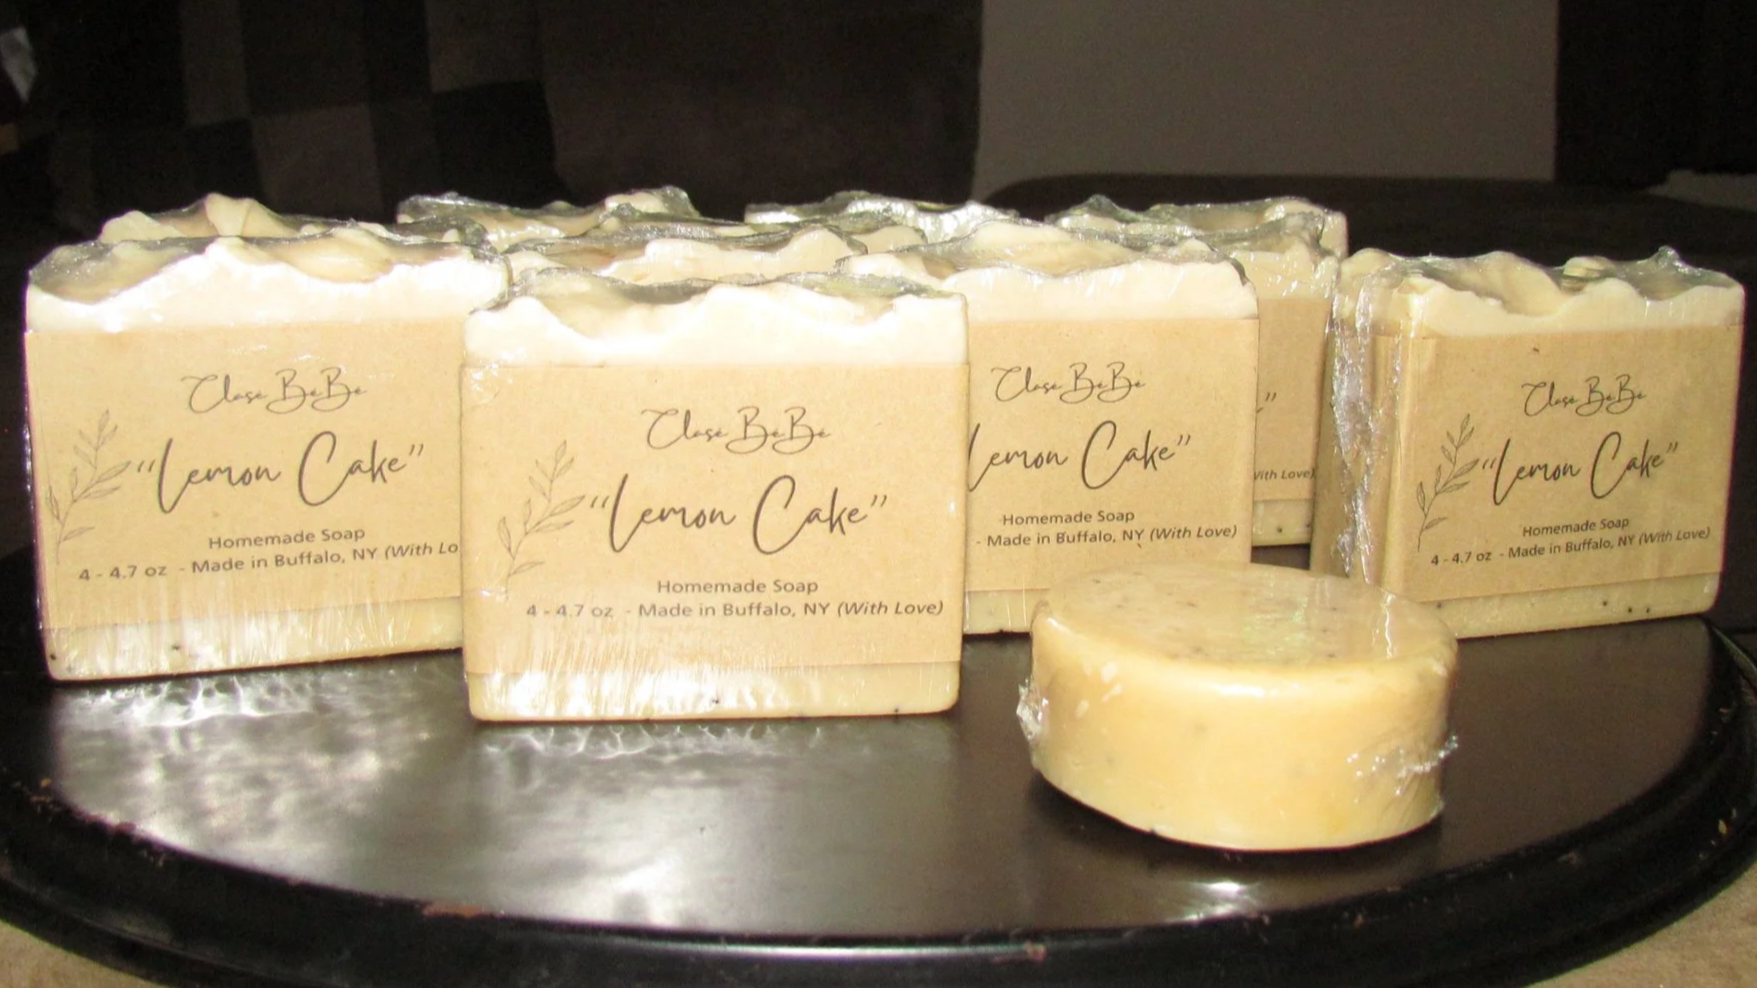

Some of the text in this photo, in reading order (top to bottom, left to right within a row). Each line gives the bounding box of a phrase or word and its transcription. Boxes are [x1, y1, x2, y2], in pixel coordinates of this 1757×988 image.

[1002, 510, 1136, 526] Homemade Soap
[1522, 517, 1630, 537] Homemade Soap
[208, 528, 366, 549] Homemade Soap
[986, 534, 1033, 547] Made
[1036, 533, 1051, 545] in
[1055, 530, 1117, 545] Buffalo,
[1122, 529, 1145, 541] NY
[1149, 528, 1191, 541] (With
[1196, 524, 1237, 540] Love)
[1430, 555, 1439, 566] 4
[1451, 551, 1472, 564] 4.7
[1476, 552, 1492, 562] oz
[1508, 545, 1546, 559] Made
[1549, 542, 1562, 554] in
[1565, 537, 1614, 554] Buffalo,
[1617, 535, 1636, 547] NY
[1638, 530, 1673, 546] (With
[1676, 526, 1711, 542] Love)
[79, 569, 91, 581] 4
[109, 565, 138, 579] 4.7
[144, 566, 168, 577] oz
[191, 558, 245, 573] Made
[251, 556, 268, 569] in
[274, 550, 346, 567] Buffalo,
[352, 548, 378, 561] NY
[384, 543, 433, 560] (With
[657, 579, 819, 595] Homemade Soap
[526, 606, 537, 618] 4
[556, 605, 584, 618] 4.7
[591, 608, 613, 618] oz
[639, 604, 693, 618] Made
[698, 603, 716, 617] in
[723, 602, 797, 619] Buffalo,
[804, 603, 829, 616] NY
[837, 602, 889, 618] (With
[894, 601, 944, 617] Love)
